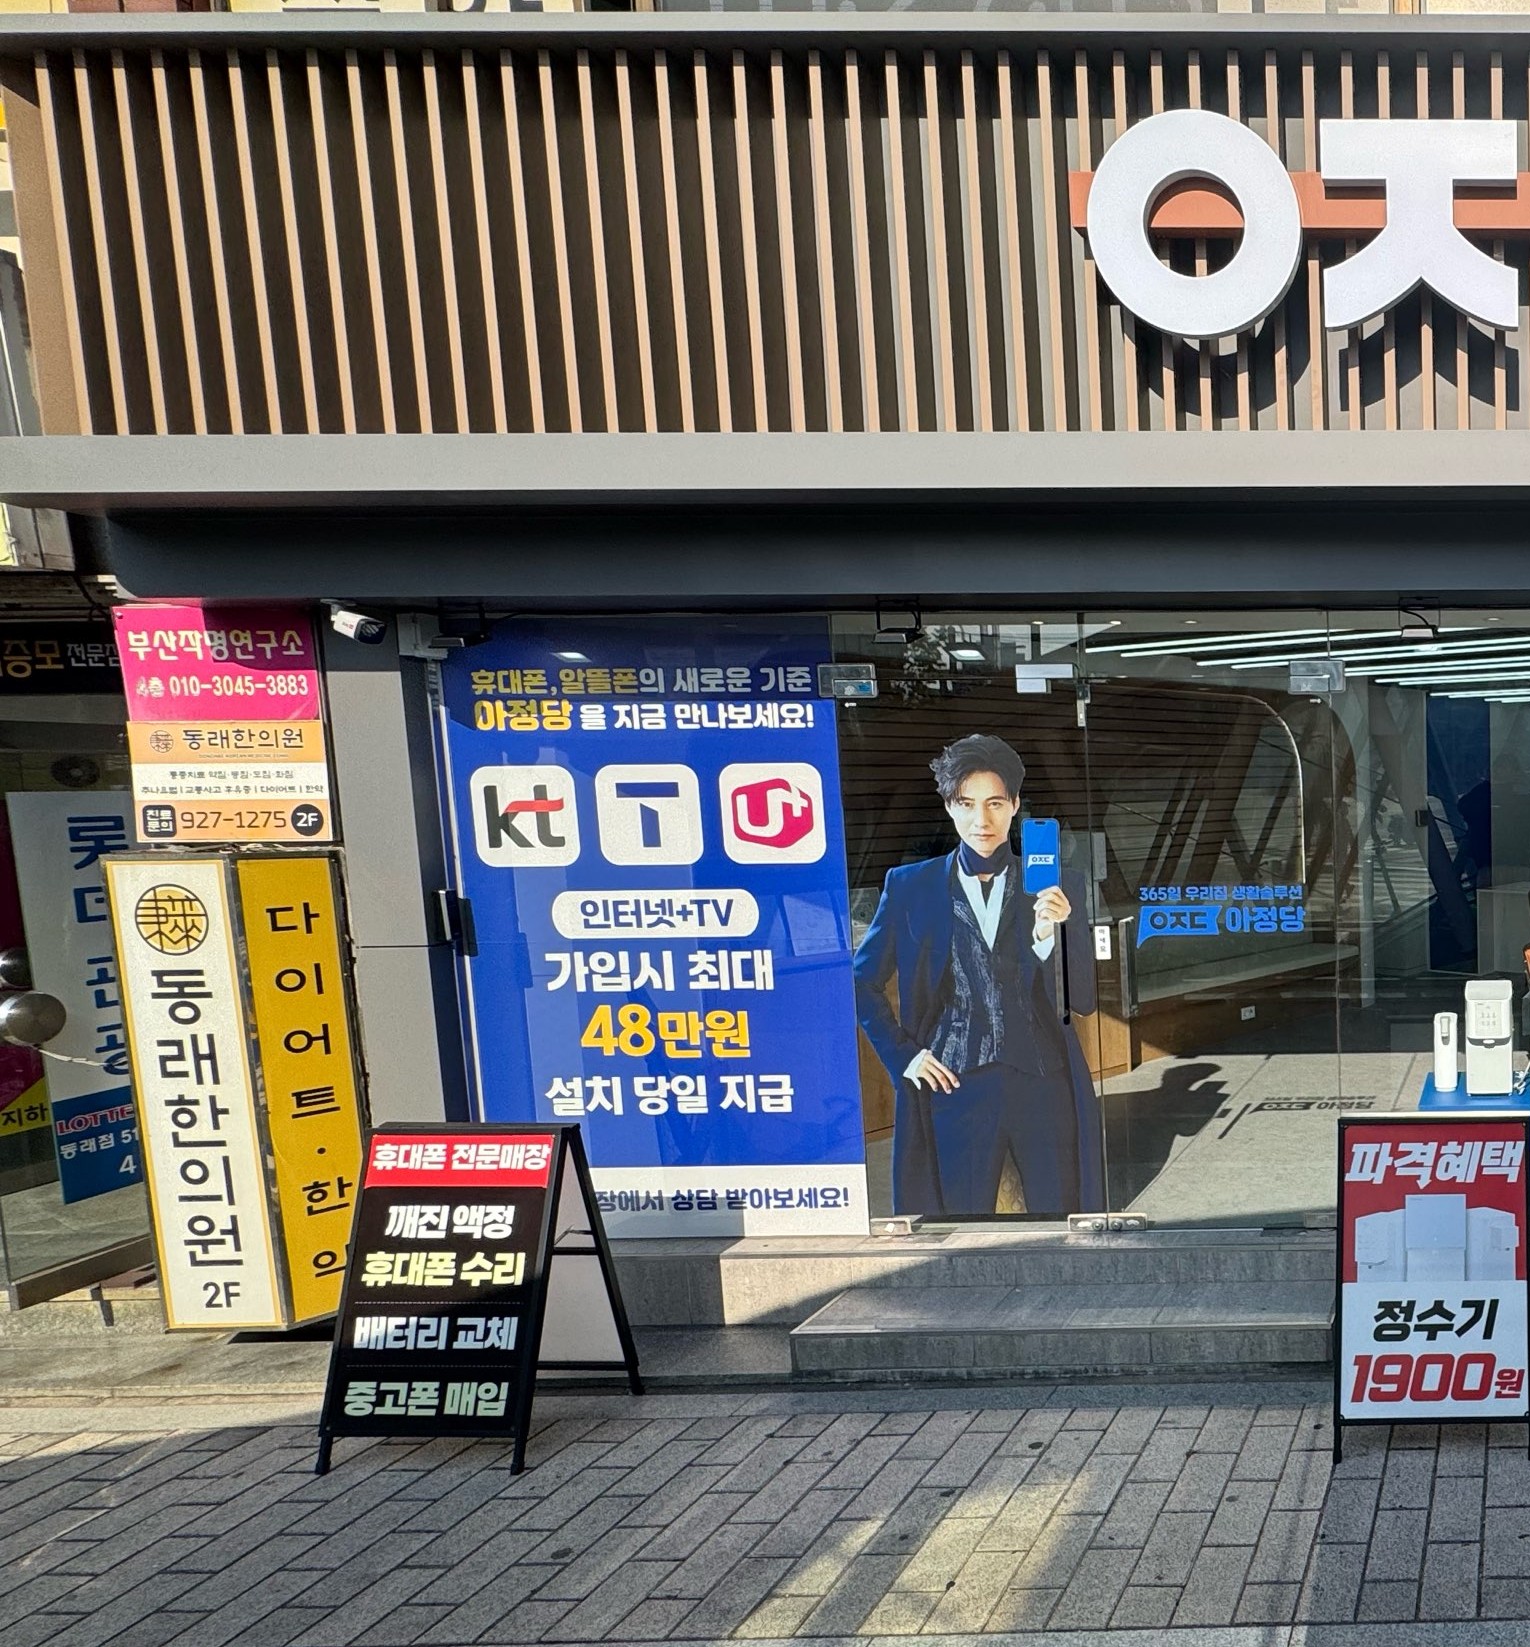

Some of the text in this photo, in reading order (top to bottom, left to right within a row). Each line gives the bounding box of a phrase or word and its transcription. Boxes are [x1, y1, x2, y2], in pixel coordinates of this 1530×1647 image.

[128, 630, 304, 661] 부산작명연구소
[170, 675, 309, 697] 010-3045-3883
[674, 667, 752, 694] 새로운
[759, 667, 812, 693] 기준
[474, 700, 815, 731] 아정당 을 지금 만나보세요!
[182, 728, 304, 750] 동래한의원
[260, 784, 297, 794] 다이어트
[146, 809, 173, 821] 진료
[147, 821, 174, 833] 문의
[181, 811, 287, 829] 927-1275
[296, 812, 319, 827] 2F
[483, 783, 567, 849] kt
[615, 782, 680, 848] T
[1139, 885, 1303, 901] 365일 우리집 생활솔루션
[580, 899, 734, 929] 인터넷+TV
[1225, 905, 1306, 932] 아정당
[545, 949, 774, 992] 가입시 최대
[580, 1004, 752, 1058] 48만원
[545, 1075, 794, 1116] 설치 당일 지급
[2, 1102, 49, 1128] 지하
[57, 1103, 134, 1136] LOTTE
[150, 969, 244, 1267] 동래한의원
[60, 1132, 115, 1160] 동래점
[372, 1144, 552, 1171] 휴대폰 전문매장
[1344, 1140, 1526, 1190] 파격혜택
[595, 1187, 850, 1212] 장에서 상담 받아보세요!
[385, 1205, 516, 1239] 깨진 액정
[360, 1251, 526, 1287] 휴대폰 수리
[203, 1281, 241, 1308] 2F
[353, 1316, 519, 1350] 배터리 교체
[1373, 1299, 1500, 1342] 정수기
[1350, 1353, 1526, 1403] 1900원
[343, 1381, 509, 1416] 중고폰 매입
